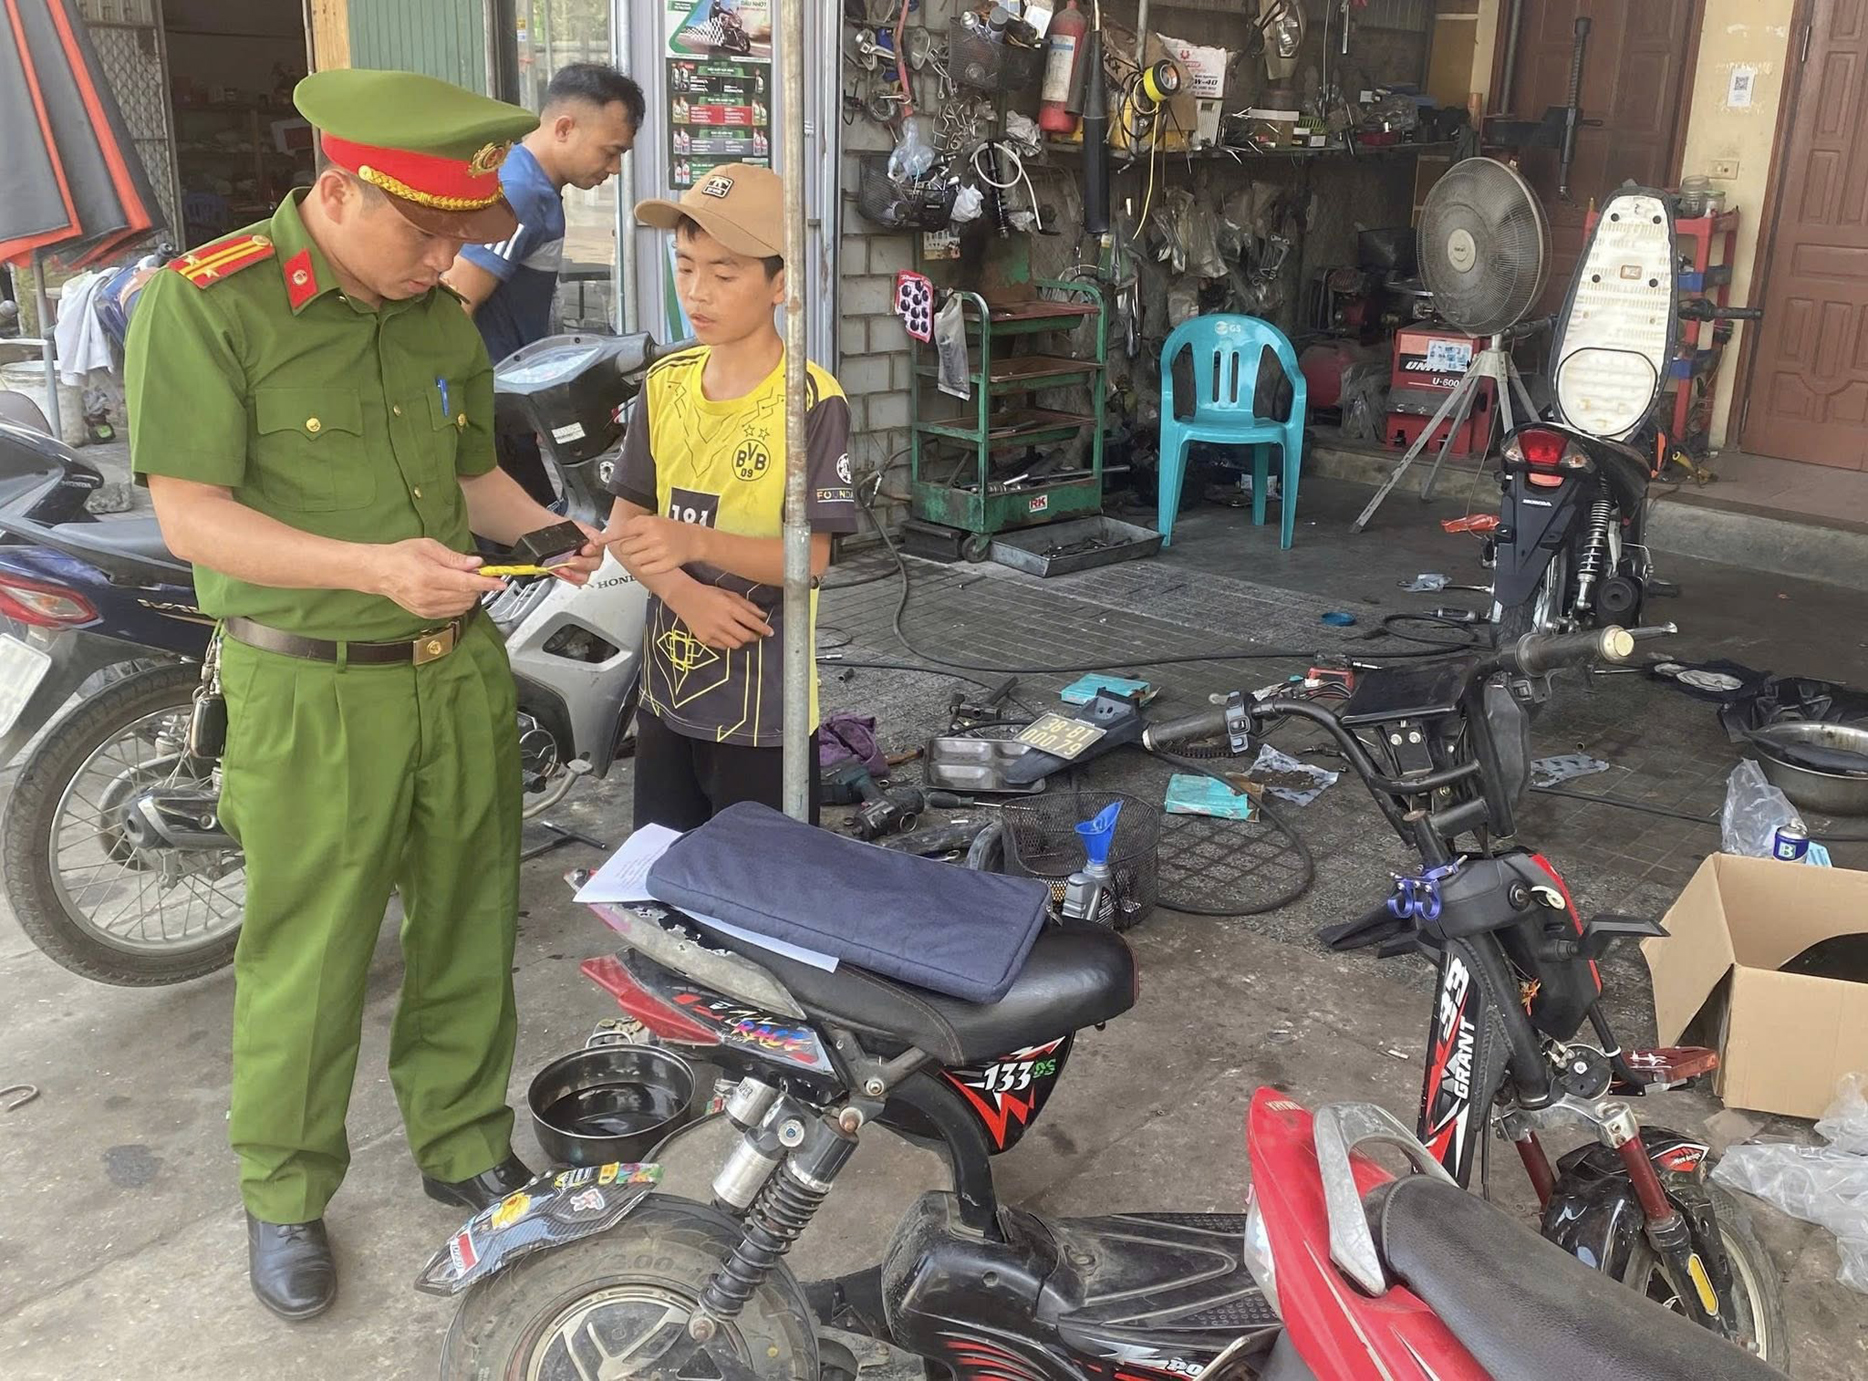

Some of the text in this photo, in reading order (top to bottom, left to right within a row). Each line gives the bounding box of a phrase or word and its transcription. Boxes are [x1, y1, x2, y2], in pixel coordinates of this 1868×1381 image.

[736, 442, 767, 471] BVB
[740, 468, 754, 478] 09
[1030, 497, 1046, 508] RK
[1453, 1015, 1475, 1100] GRANT
[984, 1061, 1034, 1091] 133
